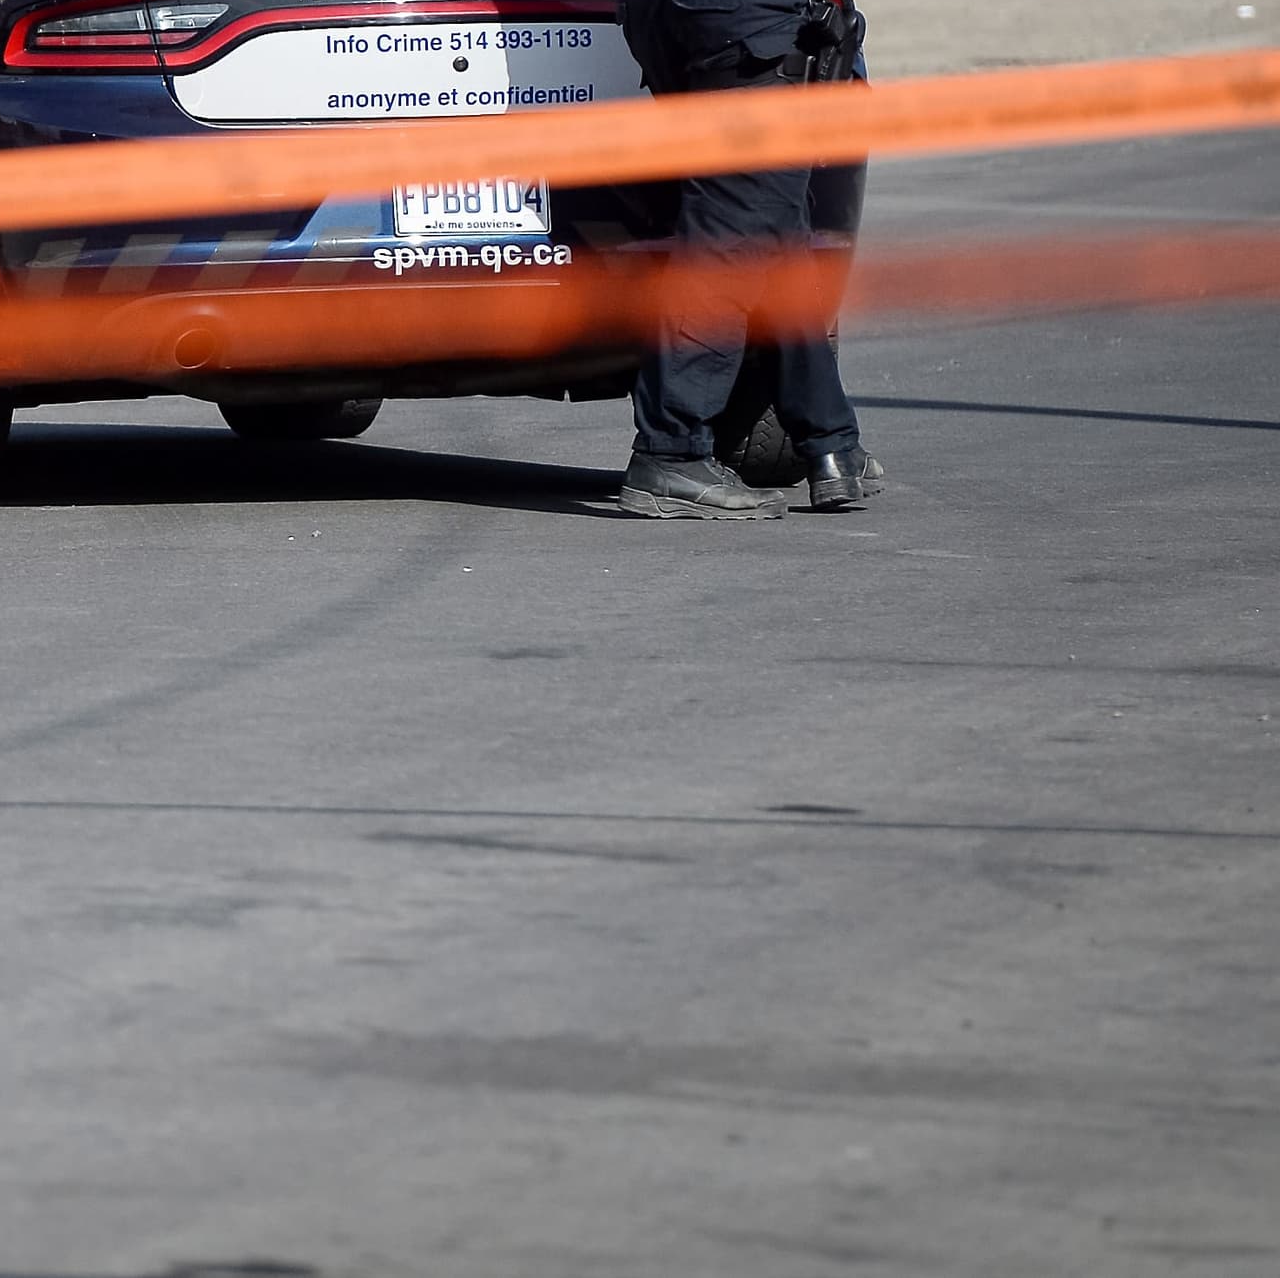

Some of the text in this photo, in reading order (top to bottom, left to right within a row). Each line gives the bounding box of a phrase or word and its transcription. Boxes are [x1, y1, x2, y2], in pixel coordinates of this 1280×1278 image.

[326, 28, 592, 54] Info Crime 514 393-1133
[327, 83, 594, 112] anonyme et confidentiel
[432, 219, 516, 229] Je me souviens
[373, 243, 573, 276] spvm.qc.ca
